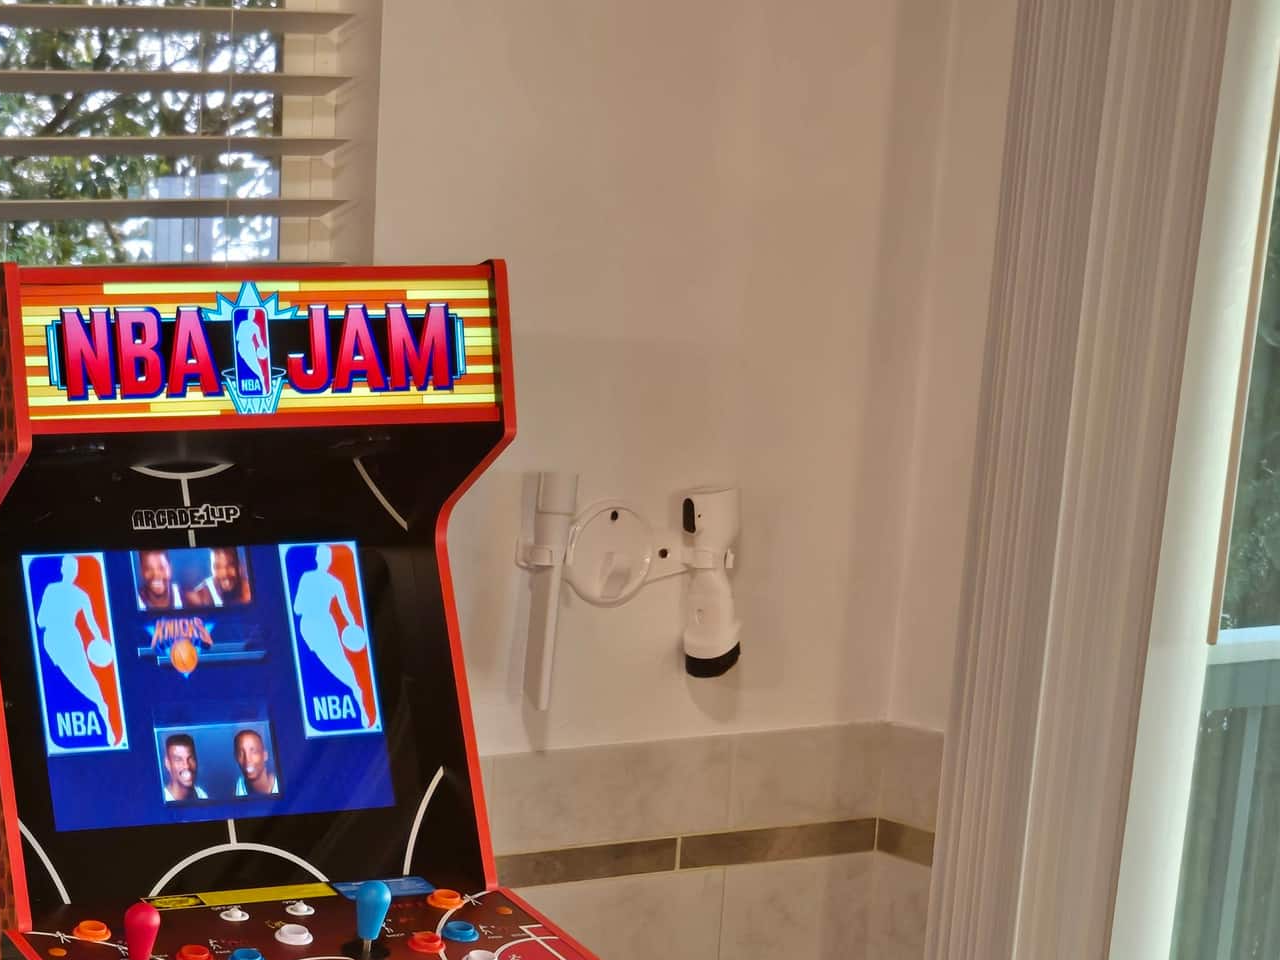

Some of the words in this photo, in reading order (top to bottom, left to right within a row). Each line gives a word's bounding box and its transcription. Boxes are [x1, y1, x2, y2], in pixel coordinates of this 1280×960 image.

[59, 304, 228, 401] NBA
[286, 301, 455, 396] JAM
[239, 377, 262, 393] NBA
[151, 616, 214, 649] KNICKS
[312, 694, 357, 721] NBA
[56, 711, 102, 738] NBA
